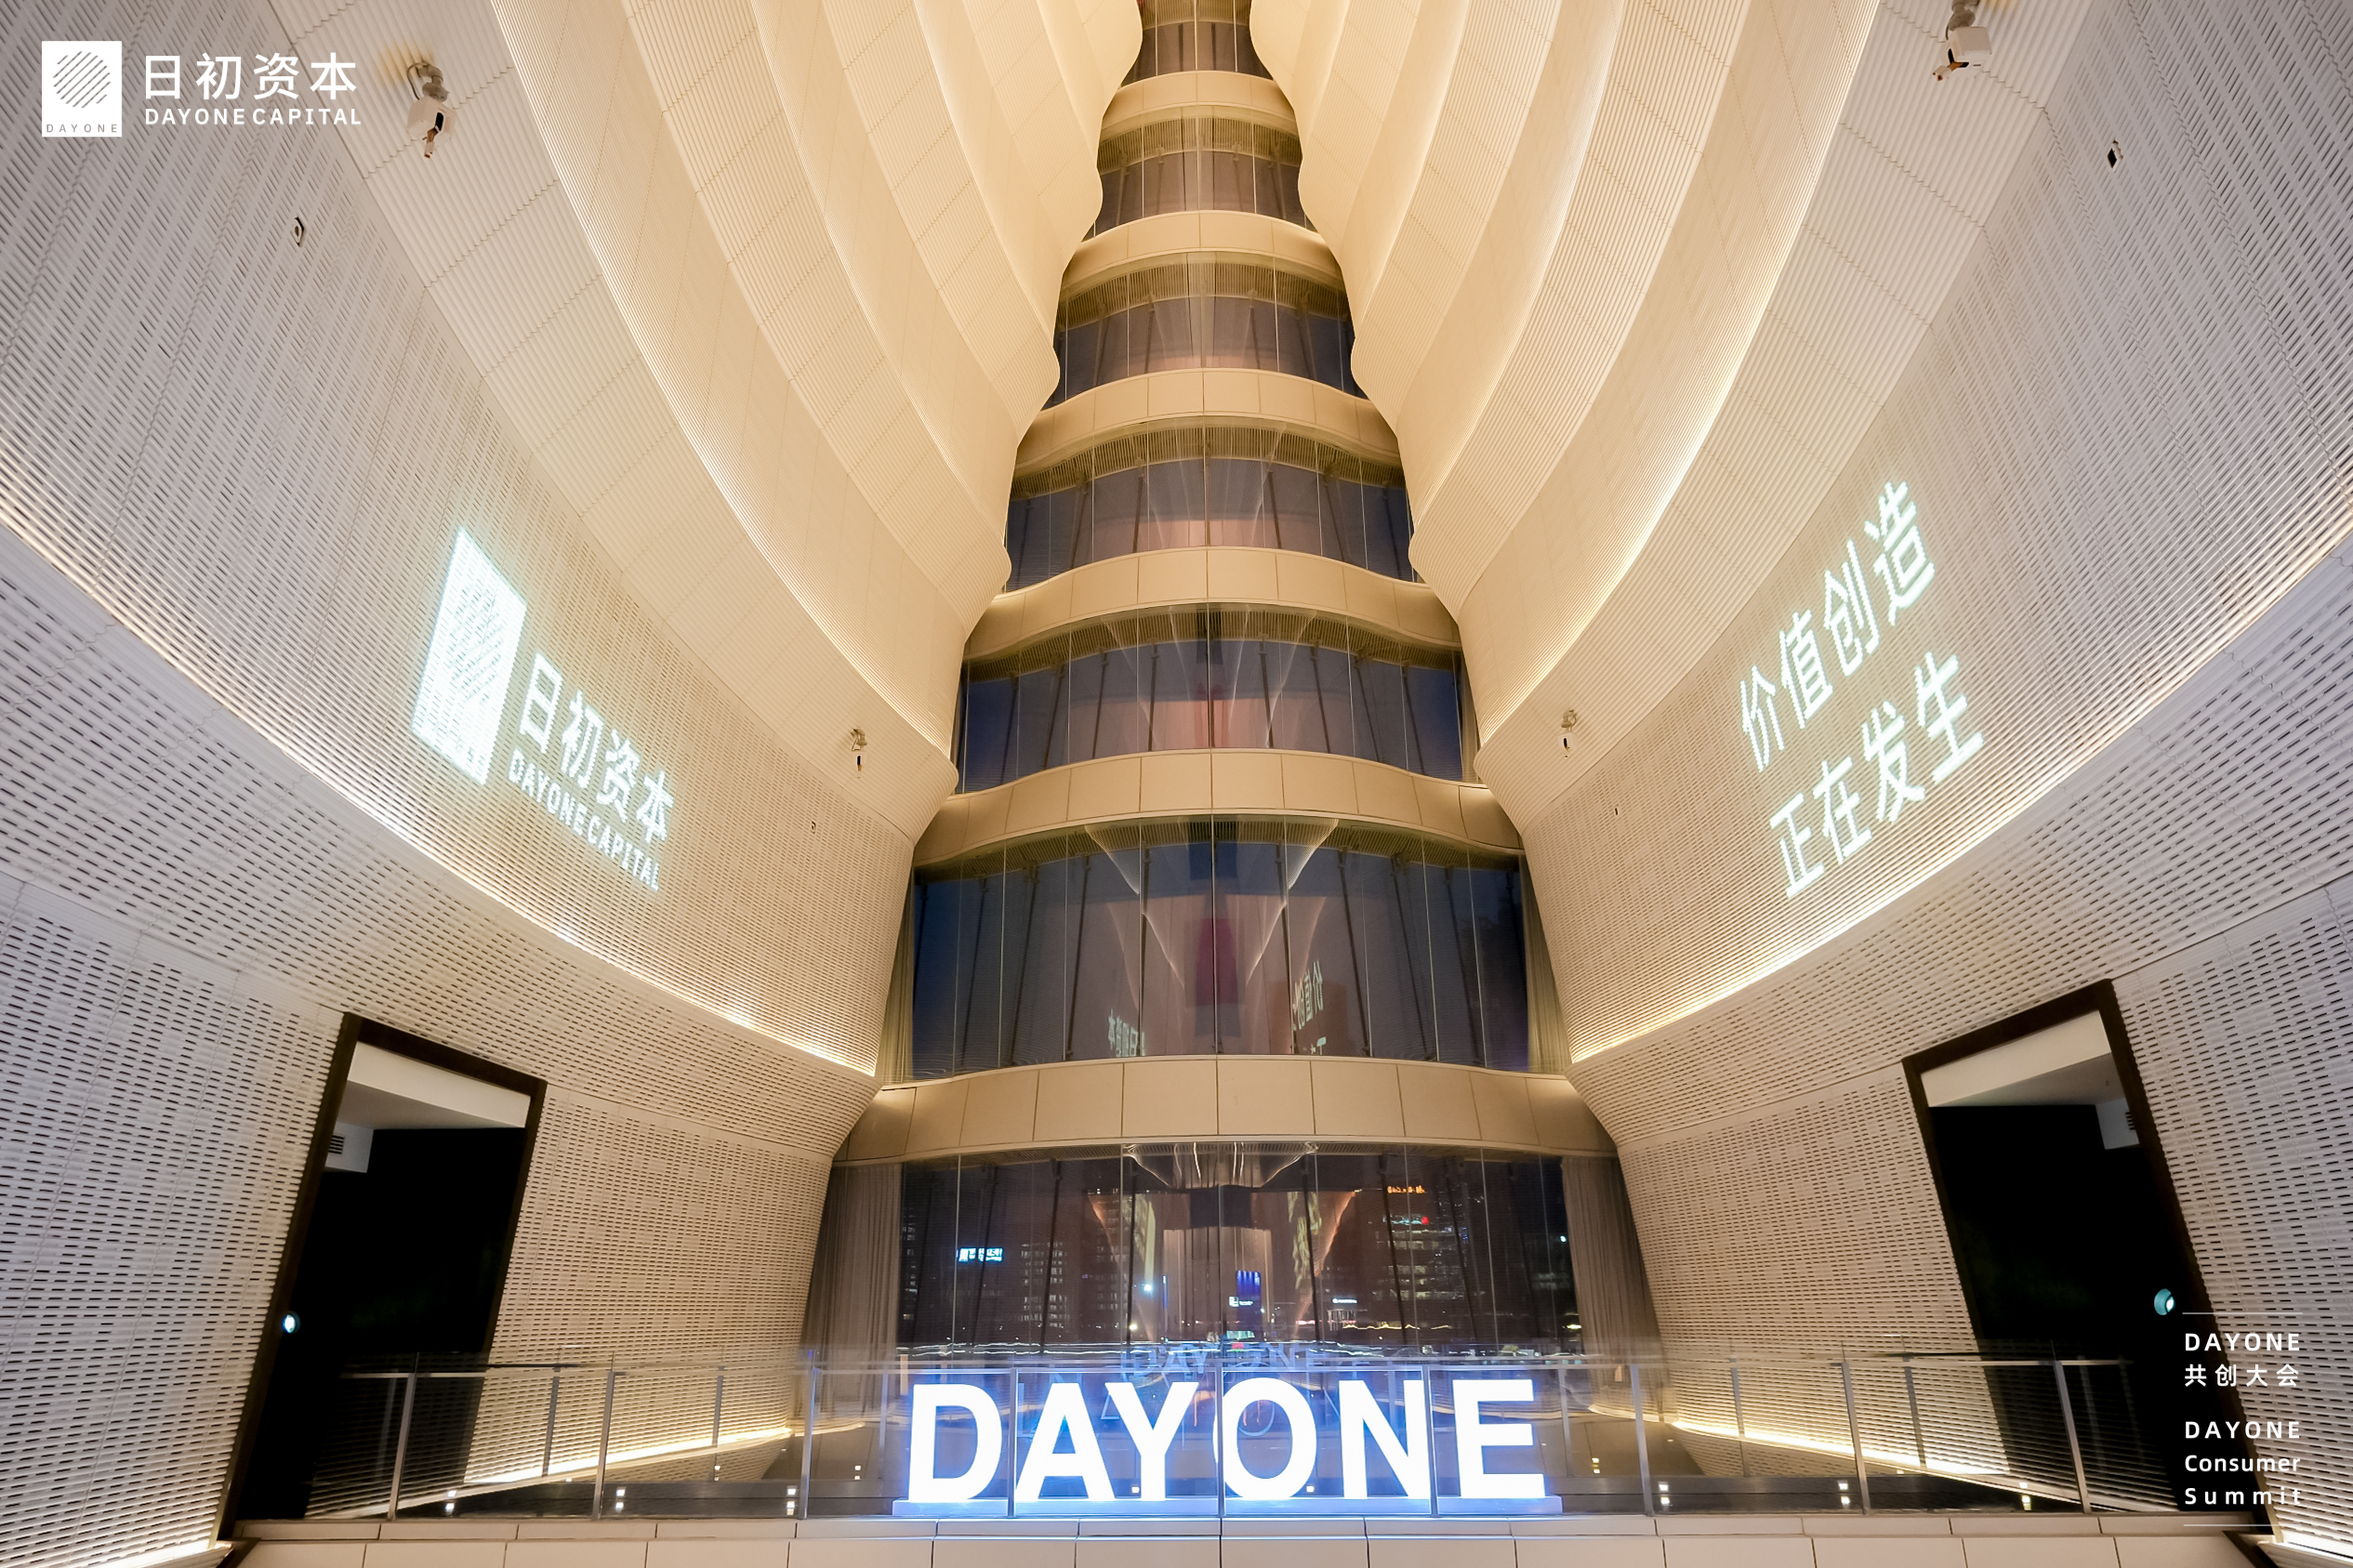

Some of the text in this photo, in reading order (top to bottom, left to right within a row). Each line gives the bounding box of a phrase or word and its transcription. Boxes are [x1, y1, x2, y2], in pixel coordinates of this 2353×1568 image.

[1740, 481, 1936, 772] 价值创造
[508, 747, 589, 837] DAYONE
[588, 814, 660, 892] CAPITAL
[519, 652, 675, 844] 日初资本
[1769, 651, 1985, 899] 正在发生
[907, 1377, 1546, 1503] DAYONE
